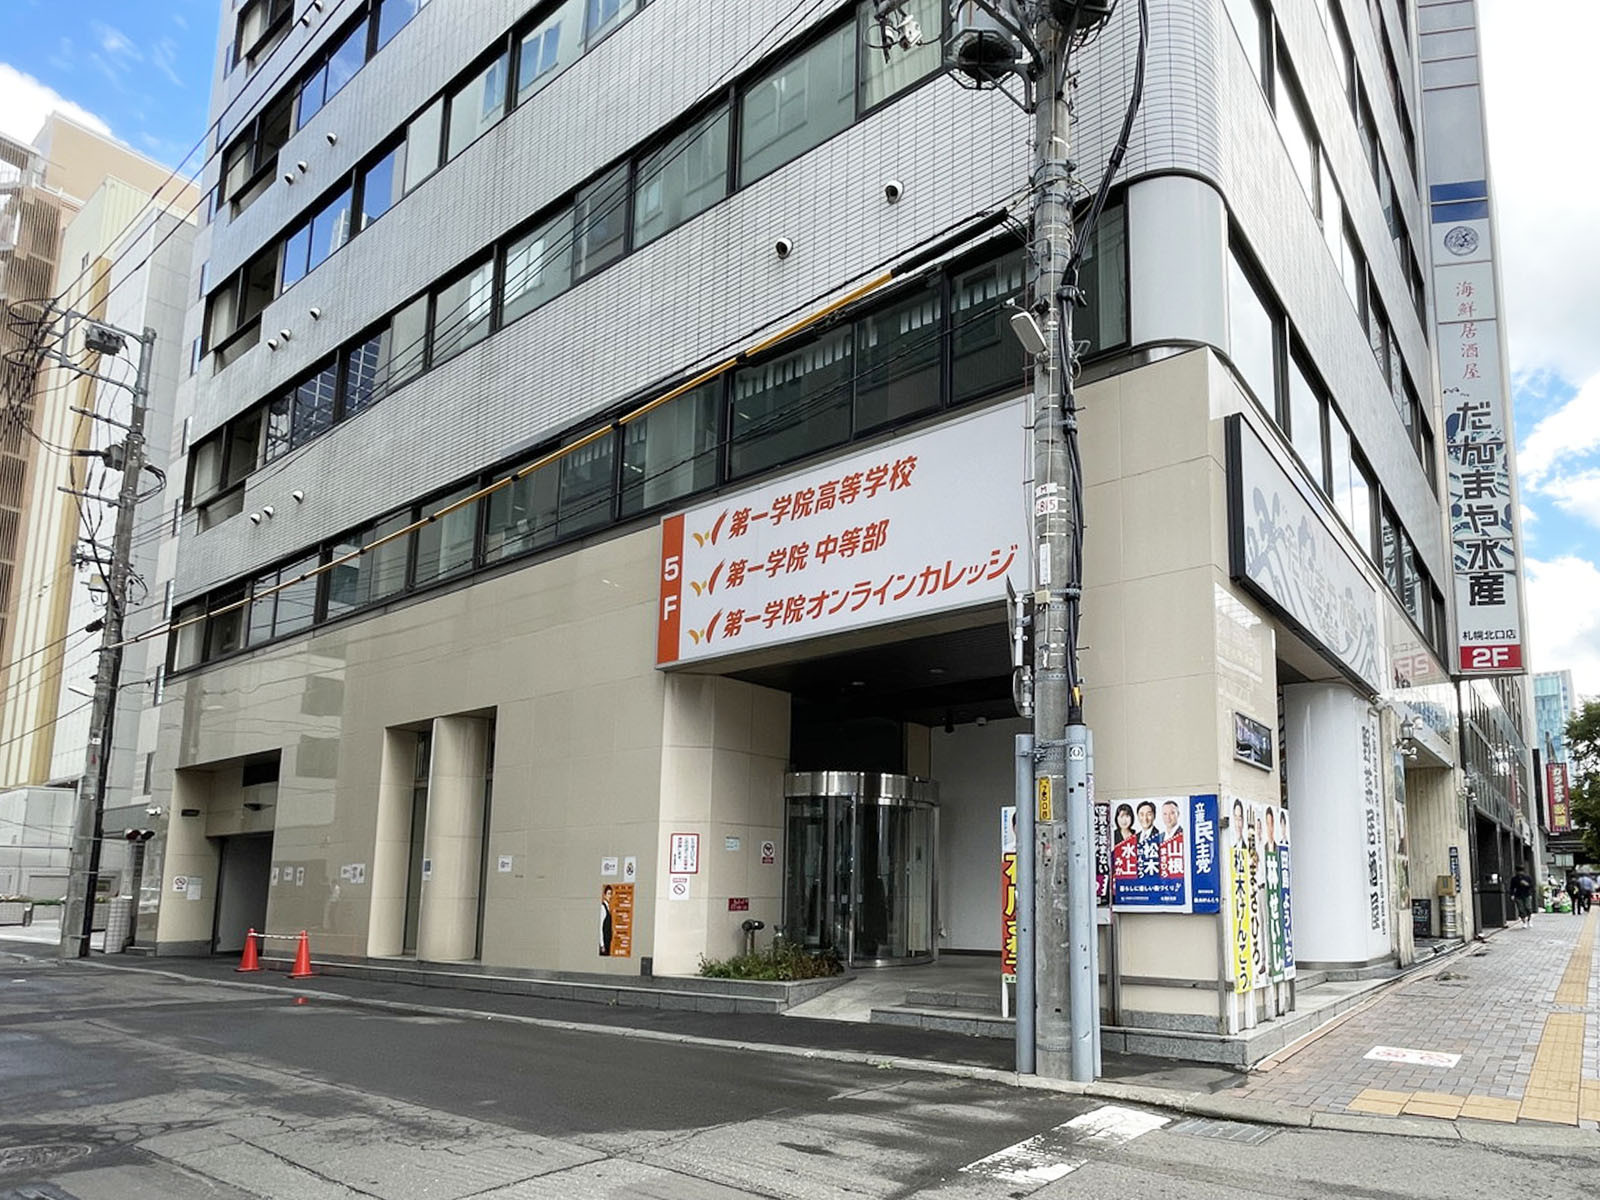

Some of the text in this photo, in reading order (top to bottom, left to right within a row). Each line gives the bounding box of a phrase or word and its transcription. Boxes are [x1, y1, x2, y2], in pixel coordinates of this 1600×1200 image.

[1456, 280, 1481, 380] 海鮮居酒屋
[728, 455, 918, 539] 第一学院高等学校
[1457, 401, 1506, 606] だんまや水産
[725, 519, 890, 590] 第一学院 中等部
[721, 544, 1019, 639] 第一学院オンラインカレッジ
[1462, 628, 1517, 641] 札幌北口店
[1472, 647, 1509, 667] 2F
[1121, 842, 1137, 876] 水上
[1143, 841, 1160, 876] 松木
[1167, 840, 1184, 874] 山根
[1233, 849, 1249, 990] 松木けんこう
